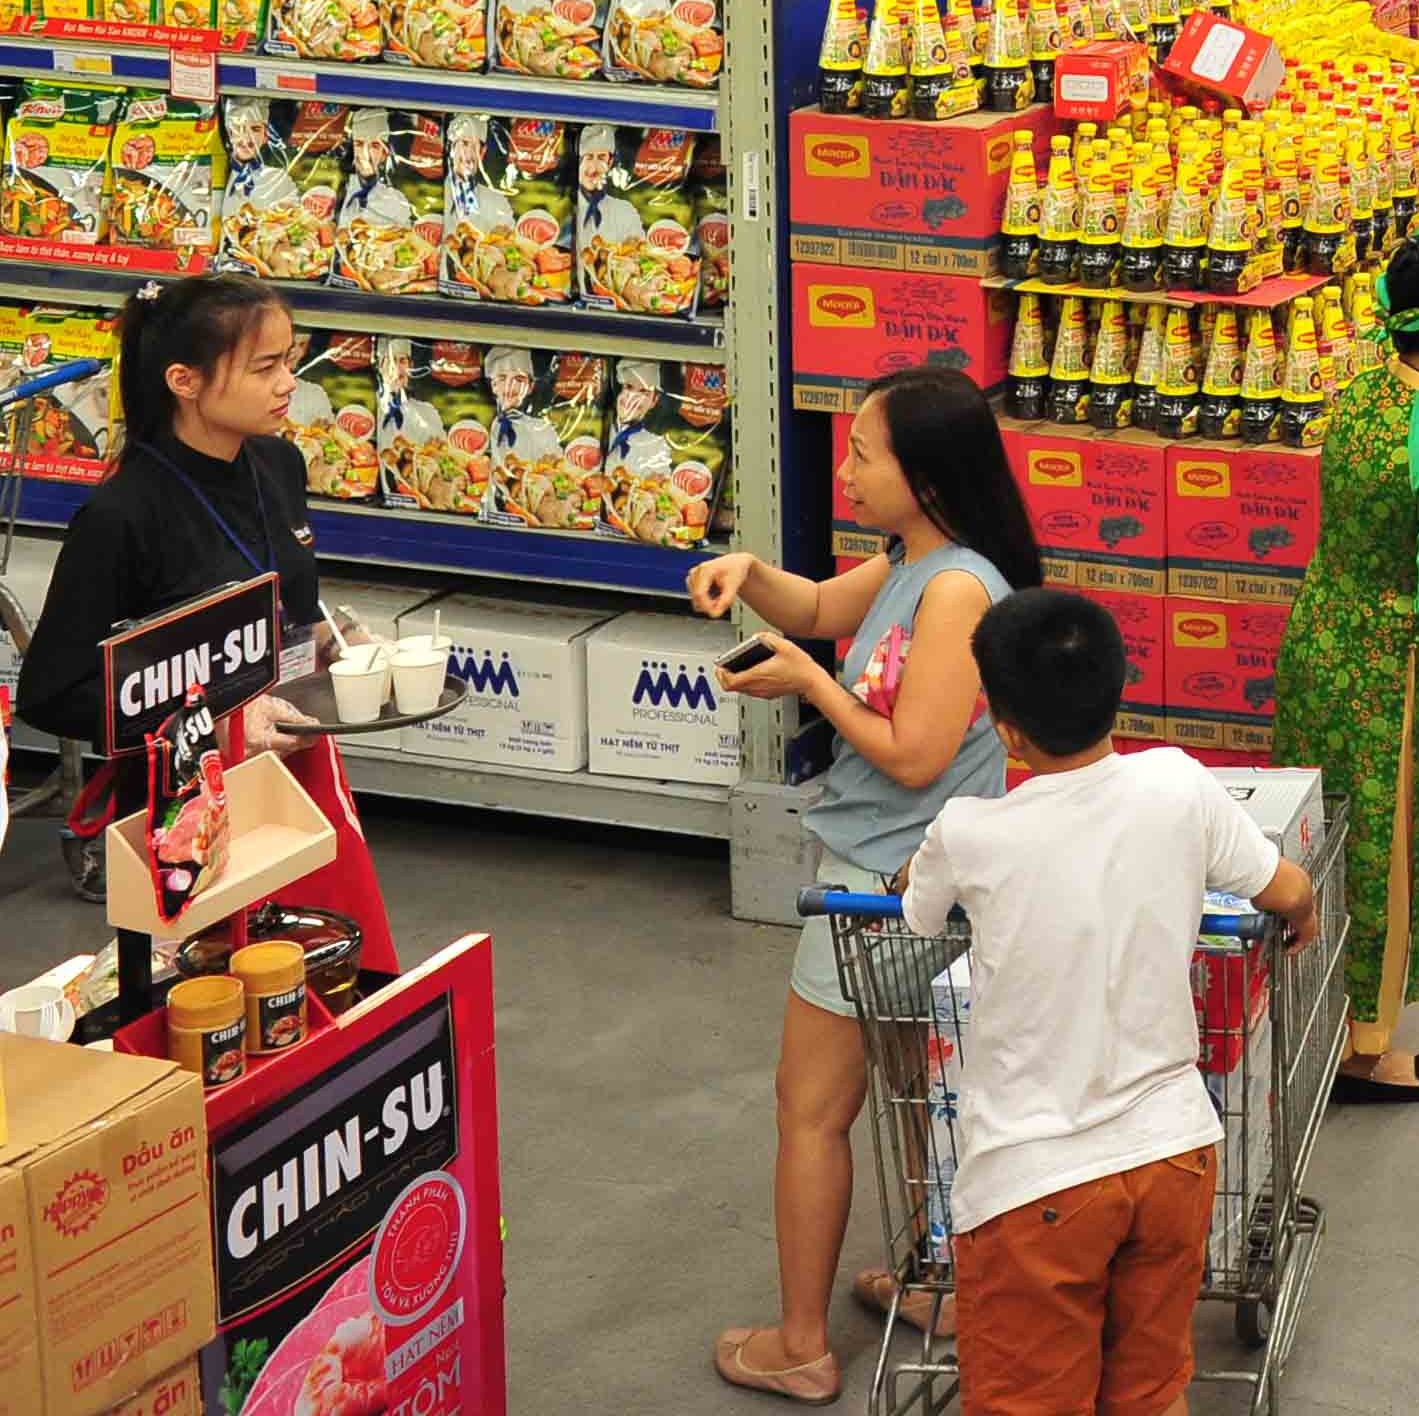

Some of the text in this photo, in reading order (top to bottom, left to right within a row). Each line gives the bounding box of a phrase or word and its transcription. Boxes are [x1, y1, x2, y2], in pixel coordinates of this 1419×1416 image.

[120, 618, 268, 717] CHIN-SU
[633, 707, 720, 727] PROFESSIONAL
[170, 1125, 196, 1149] ăn
[227, 1061, 445, 1260] CHIN-SU
